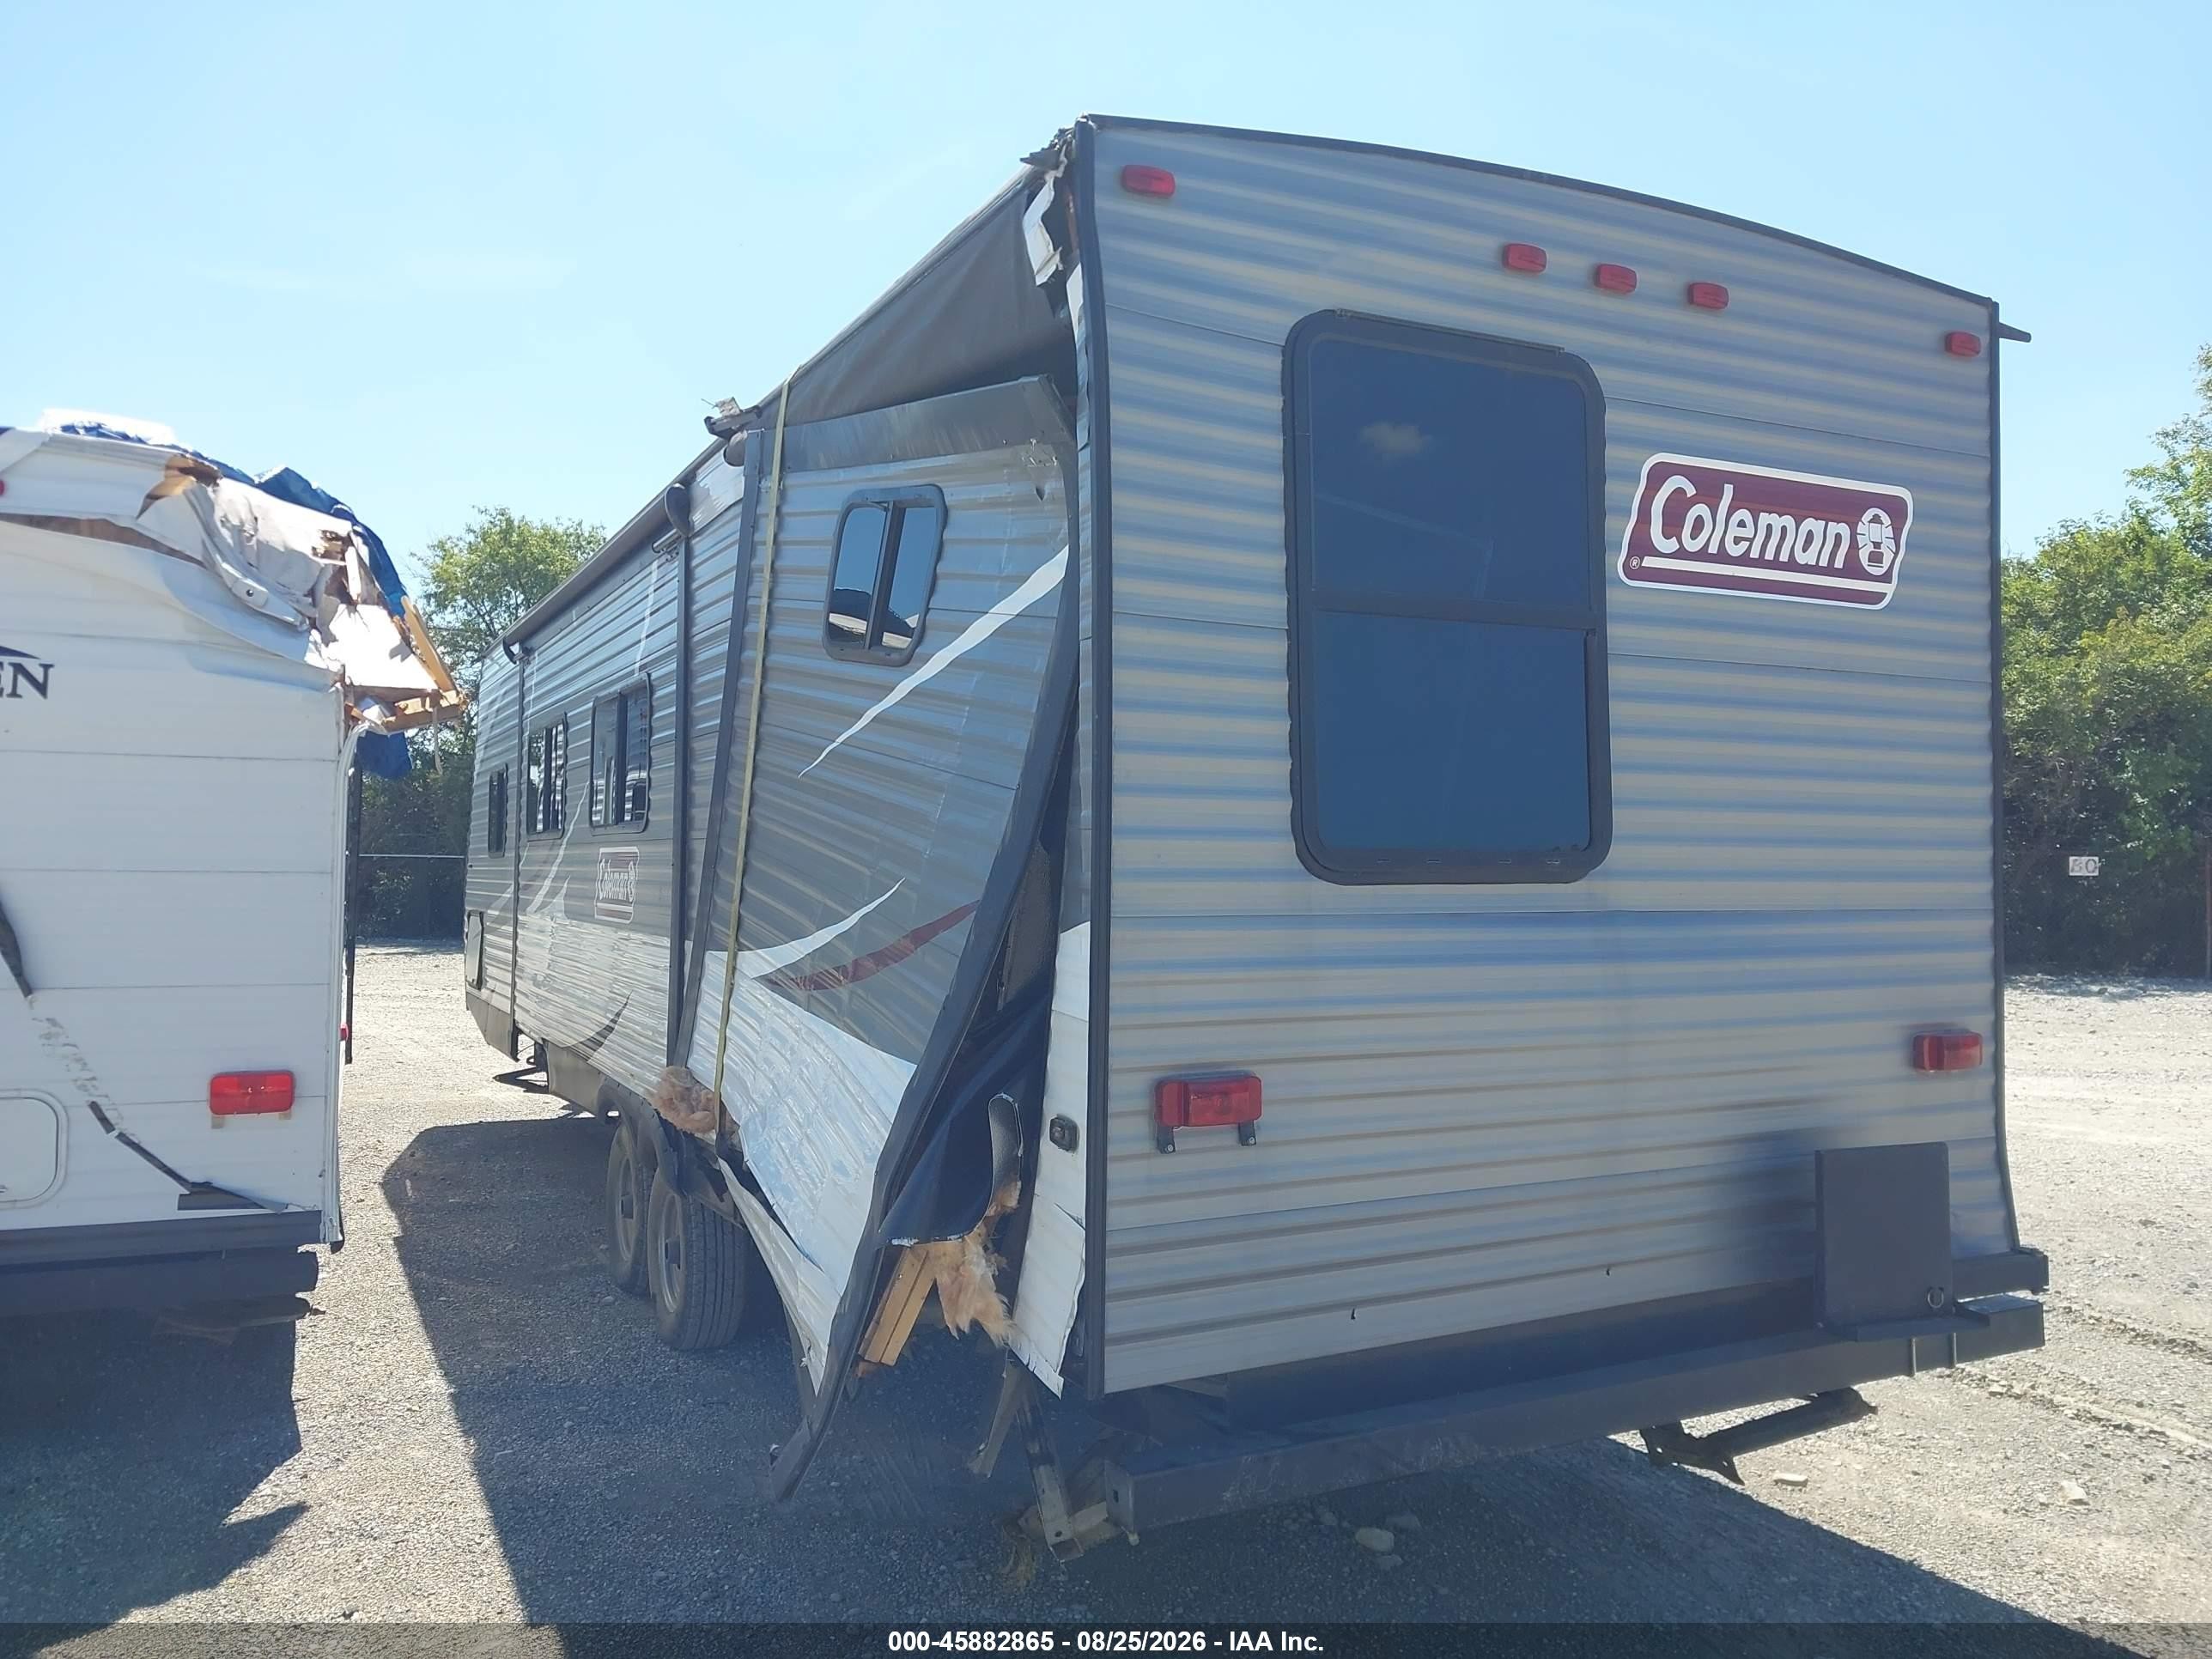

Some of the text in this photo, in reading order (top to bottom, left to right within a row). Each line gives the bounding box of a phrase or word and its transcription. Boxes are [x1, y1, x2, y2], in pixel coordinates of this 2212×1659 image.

[1650, 474, 1851, 569] Coleman
[0, 660, 55, 700] N
[599, 858, 629, 901] Coleman
